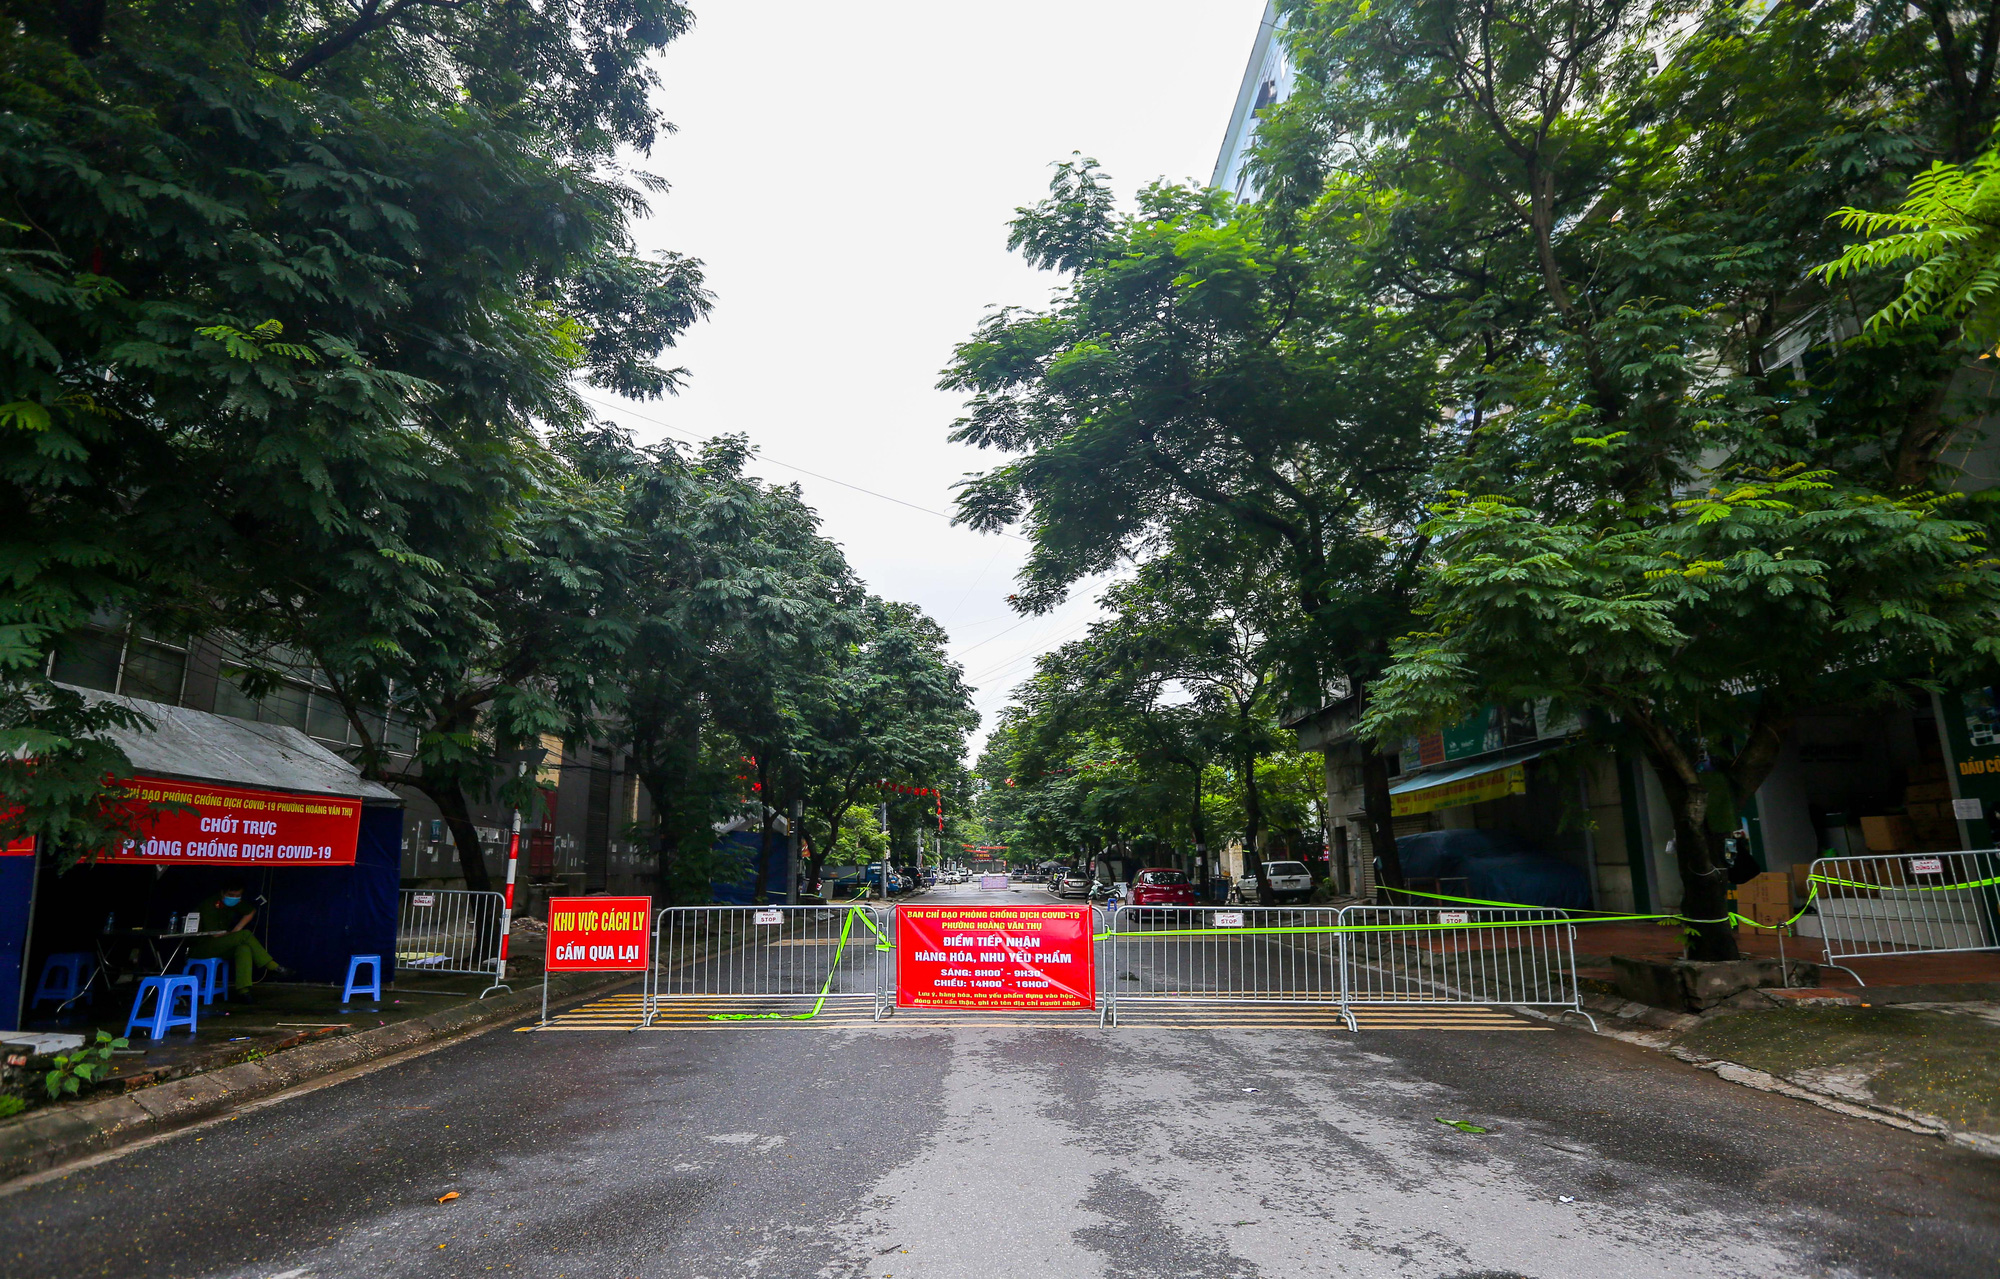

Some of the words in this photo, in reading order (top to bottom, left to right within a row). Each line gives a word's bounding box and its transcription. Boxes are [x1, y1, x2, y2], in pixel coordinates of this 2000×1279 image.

[142, 789, 160, 803] ĐẠO
[163, 790, 192, 804] PHÒNG
[194, 792, 221, 807] CHỐNG
[224, 797, 242, 810] DỊCH
[244, 799, 275, 811] COVID-19
[201, 814, 239, 834] CHỐT
[243, 819, 277, 838] TRỰC
[186, 838, 238, 858] CHỐNG
[242, 844, 274, 861] DỊCH
[277, 845, 331, 859] COVID-19
[554, 912, 575, 931] KHU
[578, 910, 598, 935] VỰC
[601, 908, 630, 931] CÁCH
[633, 912, 644, 930] LY
[926, 909, 939, 918] CHỈ
[942, 911, 957, 919] ĐẠO
[960, 910, 987, 918] PHÒNG
[990, 909, 1017, 918] CHỐNG
[1020, 912, 1041, 920] DỊCH
[942, 921, 975, 929] PHƯỜNG
[978, 921, 1005, 929] HOÀNG
[1008, 921, 1024, 929] VĂN
[1026, 922, 1042, 931] THỤ
[943, 933, 973, 947] ĐIỂM
[977, 934, 1002, 947] TIẾP
[1006, 935, 1040, 949] NHẬN
[556, 941, 585, 960] CẤM
[590, 945, 614, 961] QUA
[618, 945, 639, 962] LẠI
[915, 950, 946, 962] HÀNG
[950, 950, 976, 963] HÓA,
[980, 952, 1005, 962] NHU
[1010, 950, 1031, 963] YẾU
[1035, 950, 1071, 963] PHẨM
[941, 968, 972, 976] SÁNG:
